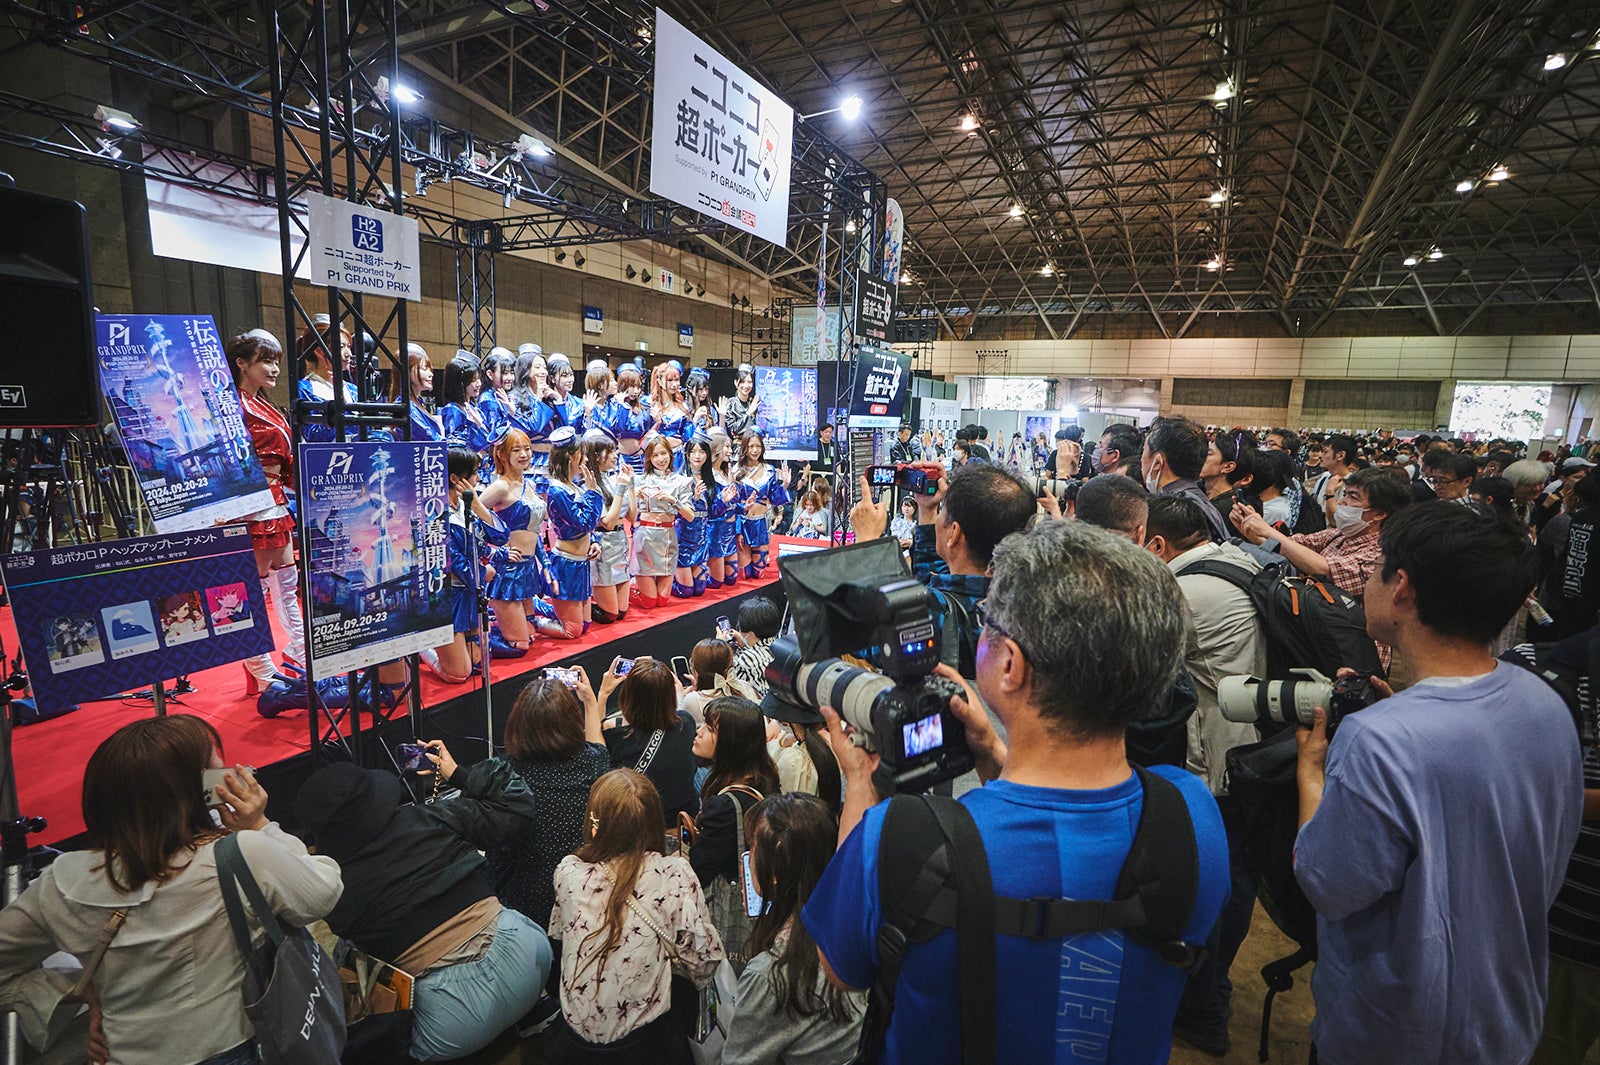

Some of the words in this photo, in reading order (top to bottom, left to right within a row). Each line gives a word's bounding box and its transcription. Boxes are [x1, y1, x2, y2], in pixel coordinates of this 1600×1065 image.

[691, 52, 761, 137] ニコニコ
[675, 99, 761, 177] 超ポーカー
[711, 171, 719, 183] P1
[719, 178, 757, 202] GRANDPRIX
[358, 217, 377, 232] H2
[357, 233, 380, 251] A2
[324, 247, 411, 271] ニコニコ超ポーカー
[343, 261, 385, 277] Supported
[386, 270, 396, 280] by
[327, 270, 341, 281] P1
[345, 273, 384, 288] GRAND
[387, 280, 411, 293] PRIX
[97, 345, 147, 356] GRANDPRIX
[193, 319, 250, 460] 伝説の幕開け
[146, 477, 208, 500] 2024.09.20-23
[311, 473, 364, 485] GRANDPRIX
[421, 446, 446, 593] 伝説の幕開け
[313, 611, 388, 638] 2024.09.20-23
[300, 986, 321, 1040] DEAN
